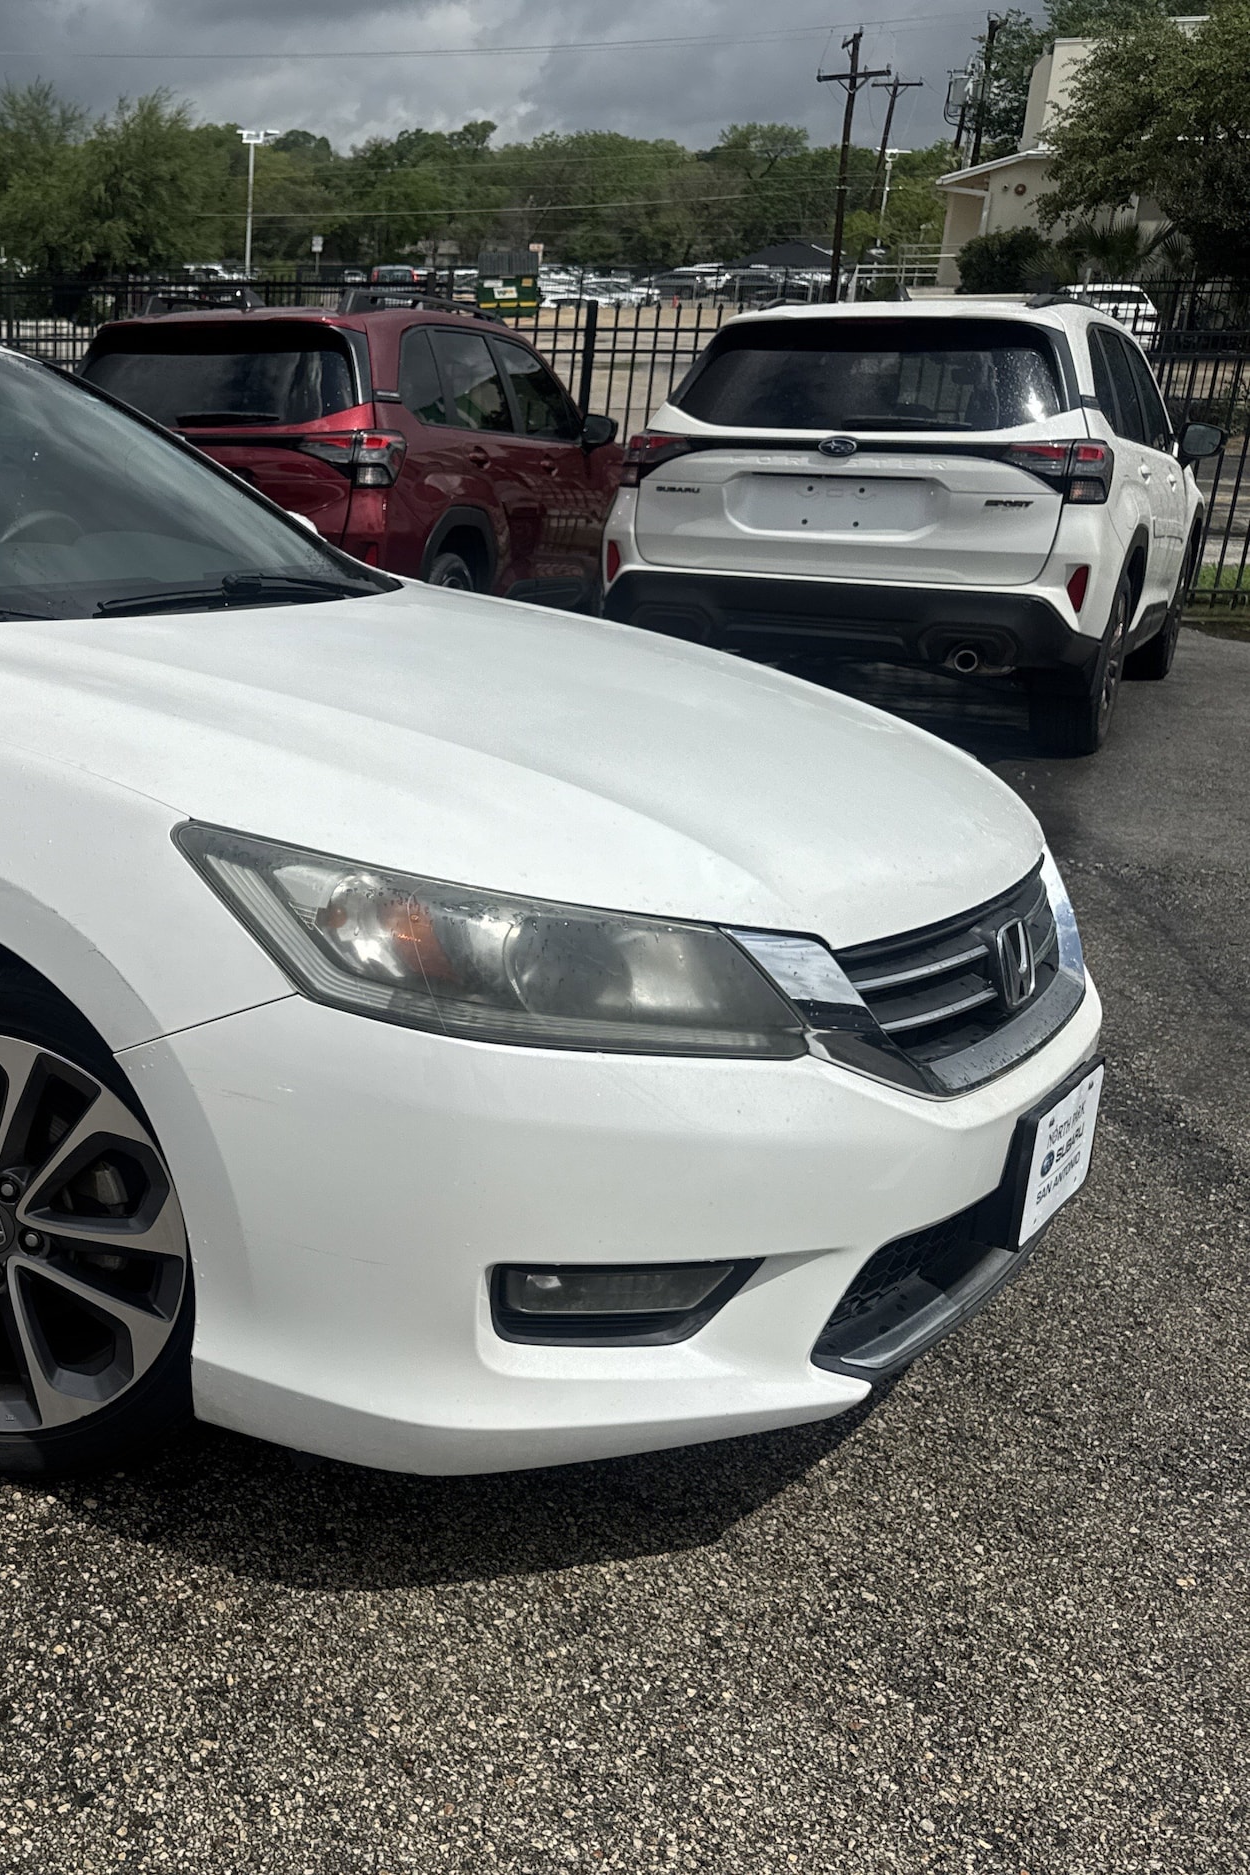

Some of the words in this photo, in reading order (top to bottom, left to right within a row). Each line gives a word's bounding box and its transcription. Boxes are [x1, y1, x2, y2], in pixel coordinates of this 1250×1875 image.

[730, 456, 949, 471] FORSTER
[655, 486, 700, 494] SUBARU
[984, 499, 1034, 508] SPORT
[1046, 1116, 1072, 1150] NORTH
[1055, 1121, 1085, 1163] SUBARU
[1036, 1180, 1053, 1206] SAN
[1052, 1150, 1081, 1191] ANTONIO
